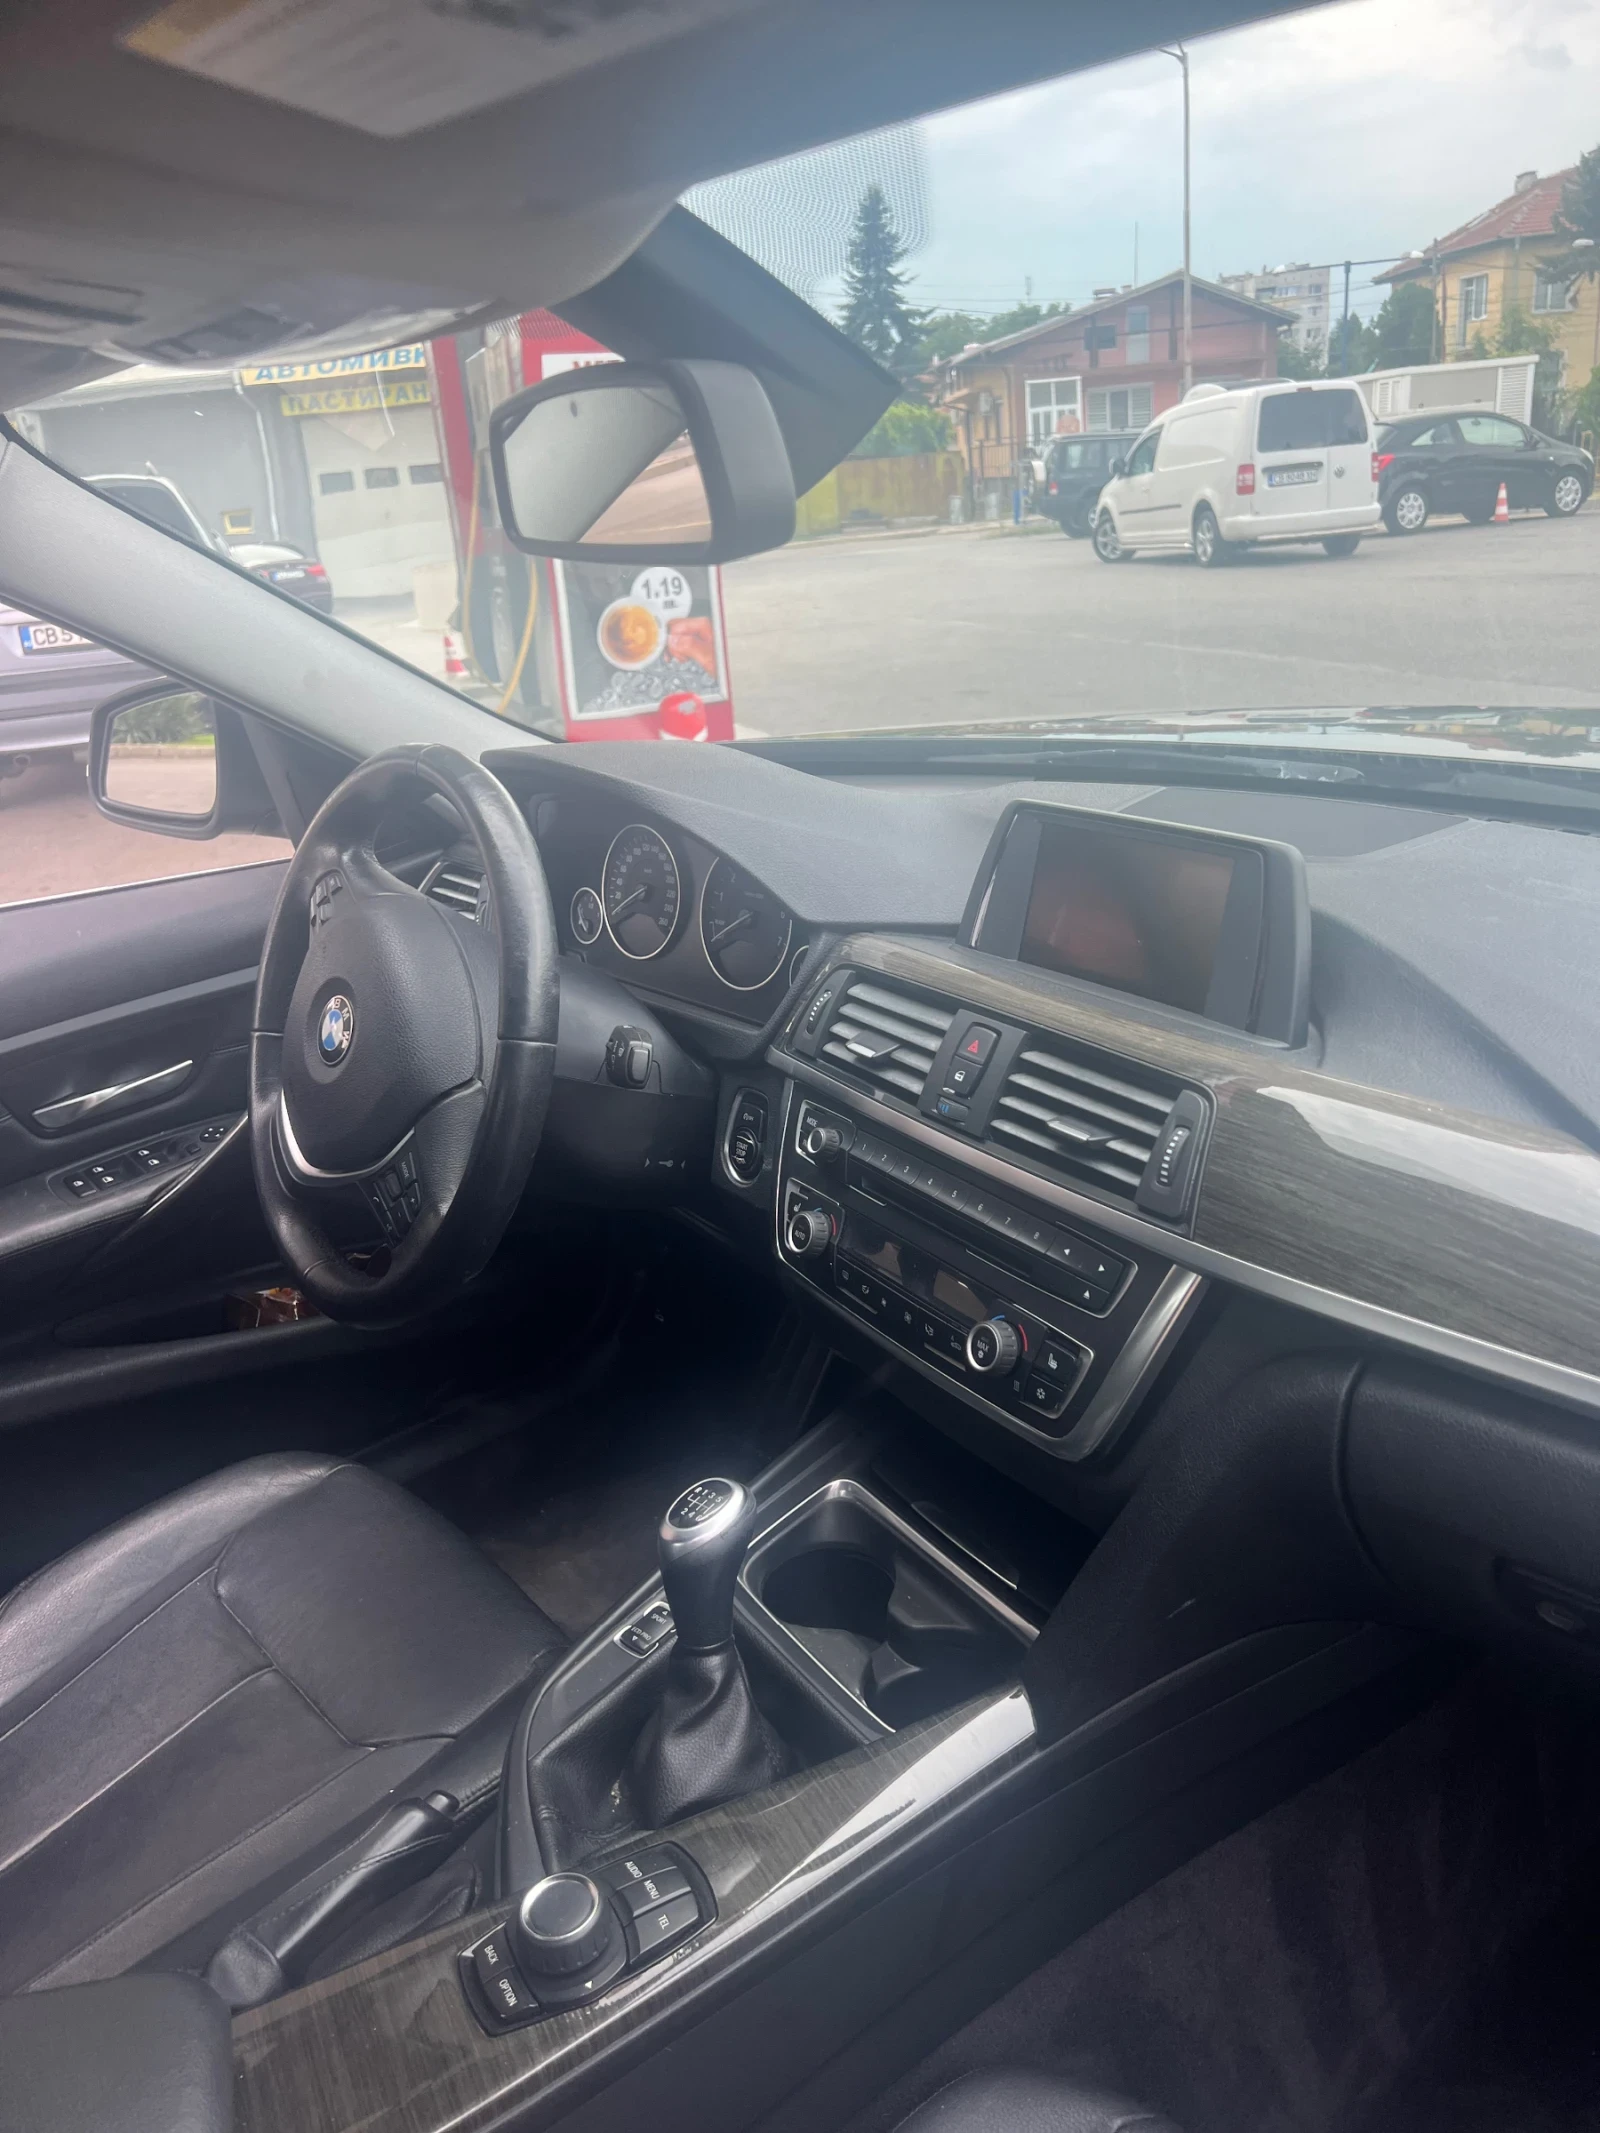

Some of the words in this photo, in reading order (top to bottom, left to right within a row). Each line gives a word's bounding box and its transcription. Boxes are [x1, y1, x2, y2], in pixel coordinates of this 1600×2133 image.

[641, 576, 683, 599] 1.19
[664, 904, 673, 912] 240
[658, 917, 669, 926] 260
[862, 1143, 867, 1151] 1
[401, 1161, 409, 1178] MODE
[903, 1165, 910, 1173] 3
[951, 1190, 957, 1198] 5
[977, 1203, 984, 1211] 6
[1004, 1216, 1011, 1225] 7
[1033, 1231, 1040, 1240] 8
[976, 1339, 990, 1353] MAX
[680, 1507, 688, 1516] 2
[651, 1613, 667, 1625] SPORT
[631, 1626, 642, 1634] ECO
[624, 1861, 643, 1878] AUDIO
[643, 1879, 660, 1899] MENU
[658, 1914, 670, 1930] TEL
[484, 1944, 499, 1965] BACK
[499, 1978, 518, 2007] OPTION
